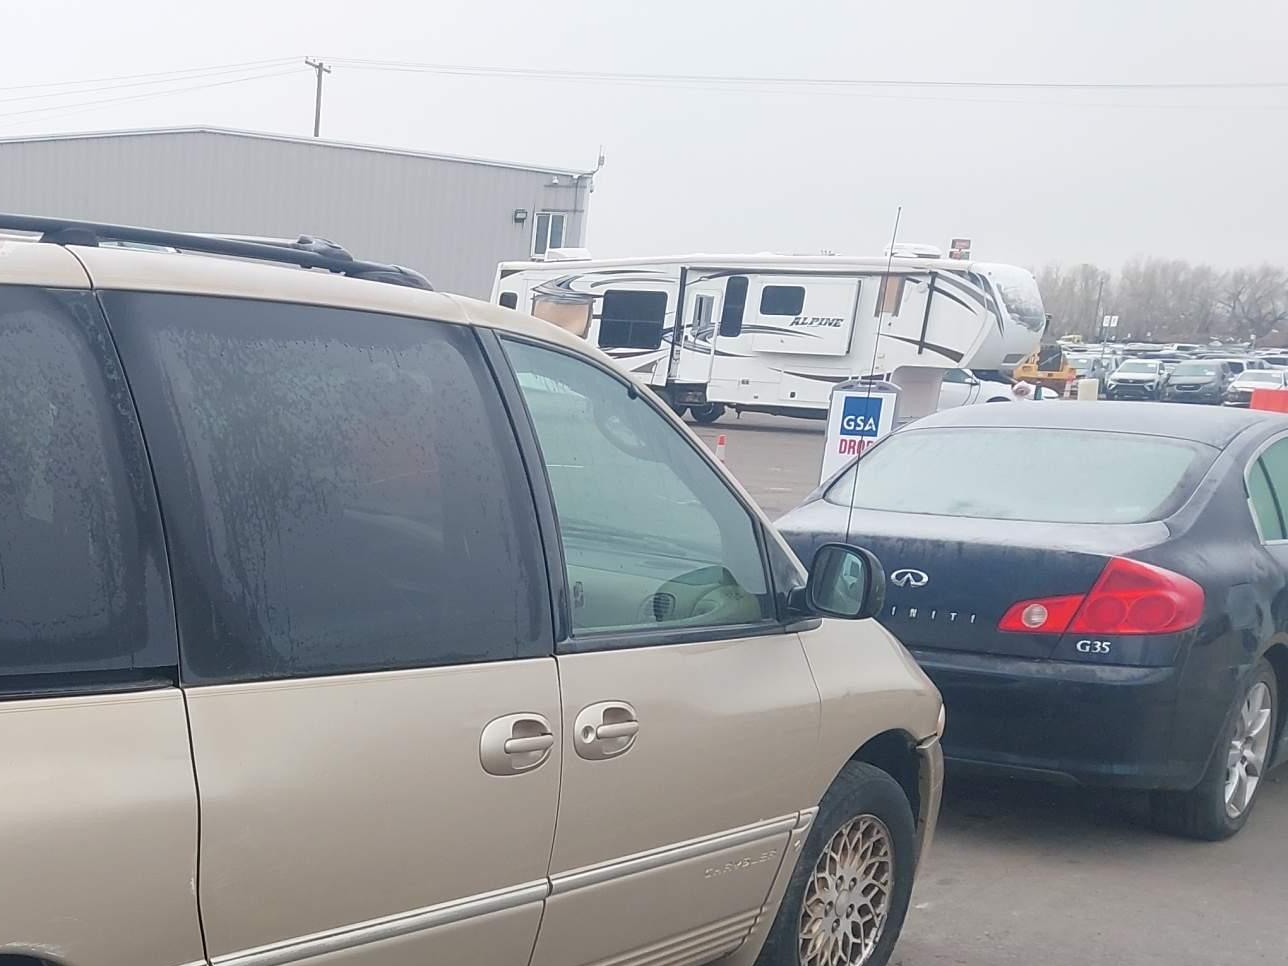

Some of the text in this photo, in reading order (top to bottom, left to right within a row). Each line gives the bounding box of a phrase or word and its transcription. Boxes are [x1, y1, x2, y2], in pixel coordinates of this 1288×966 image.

[789, 316, 845, 328] ALPINE
[843, 415, 877, 431] GSA
[1076, 639, 1112, 654] G35
